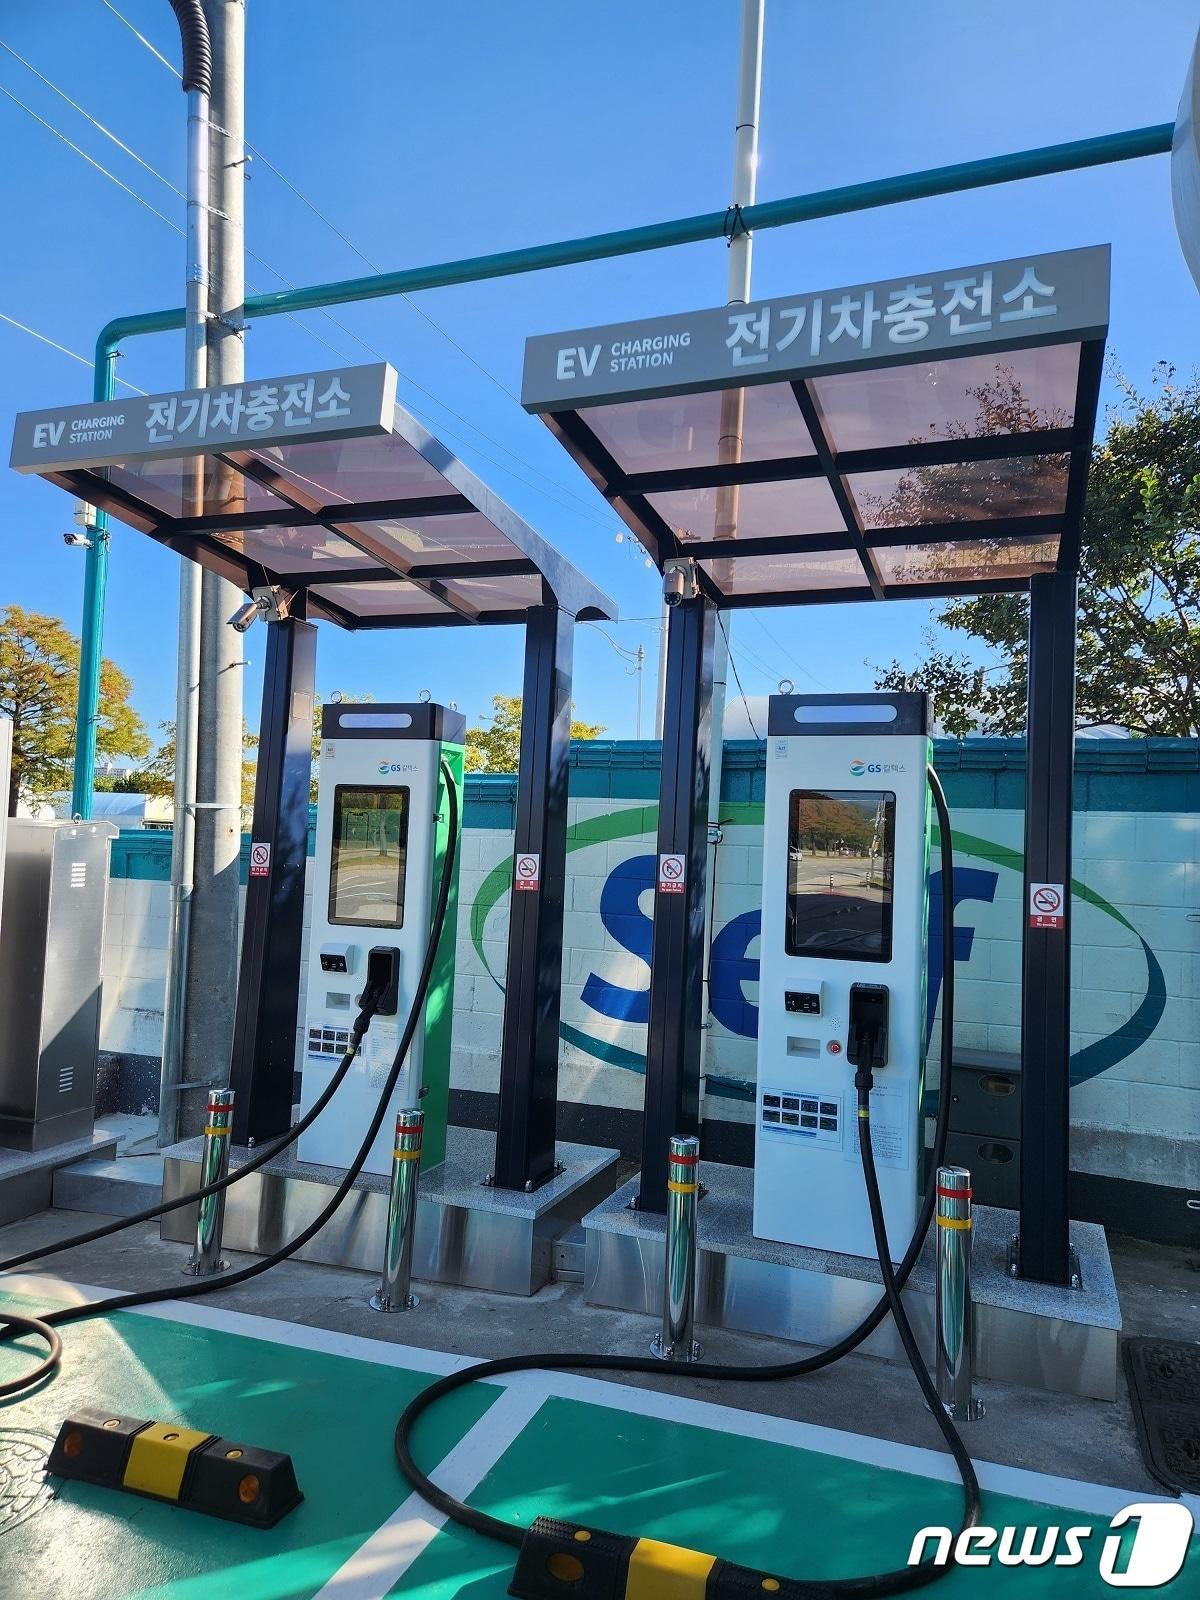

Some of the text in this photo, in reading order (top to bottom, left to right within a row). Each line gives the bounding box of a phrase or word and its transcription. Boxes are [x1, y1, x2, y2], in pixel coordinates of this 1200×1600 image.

[725, 266, 1058, 367] 전기차충전소
[611, 332, 691, 356] CHARGING
[556, 344, 602, 381] EV
[610, 352, 673, 373] STATION
[145, 376, 352, 443] 전기차충전소
[71, 414, 125, 431] CHARGING
[33, 421, 65, 449] EV
[69, 429, 113, 445] STATION
[390, 764, 401, 772] GS
[867, 764, 882, 773] GS
